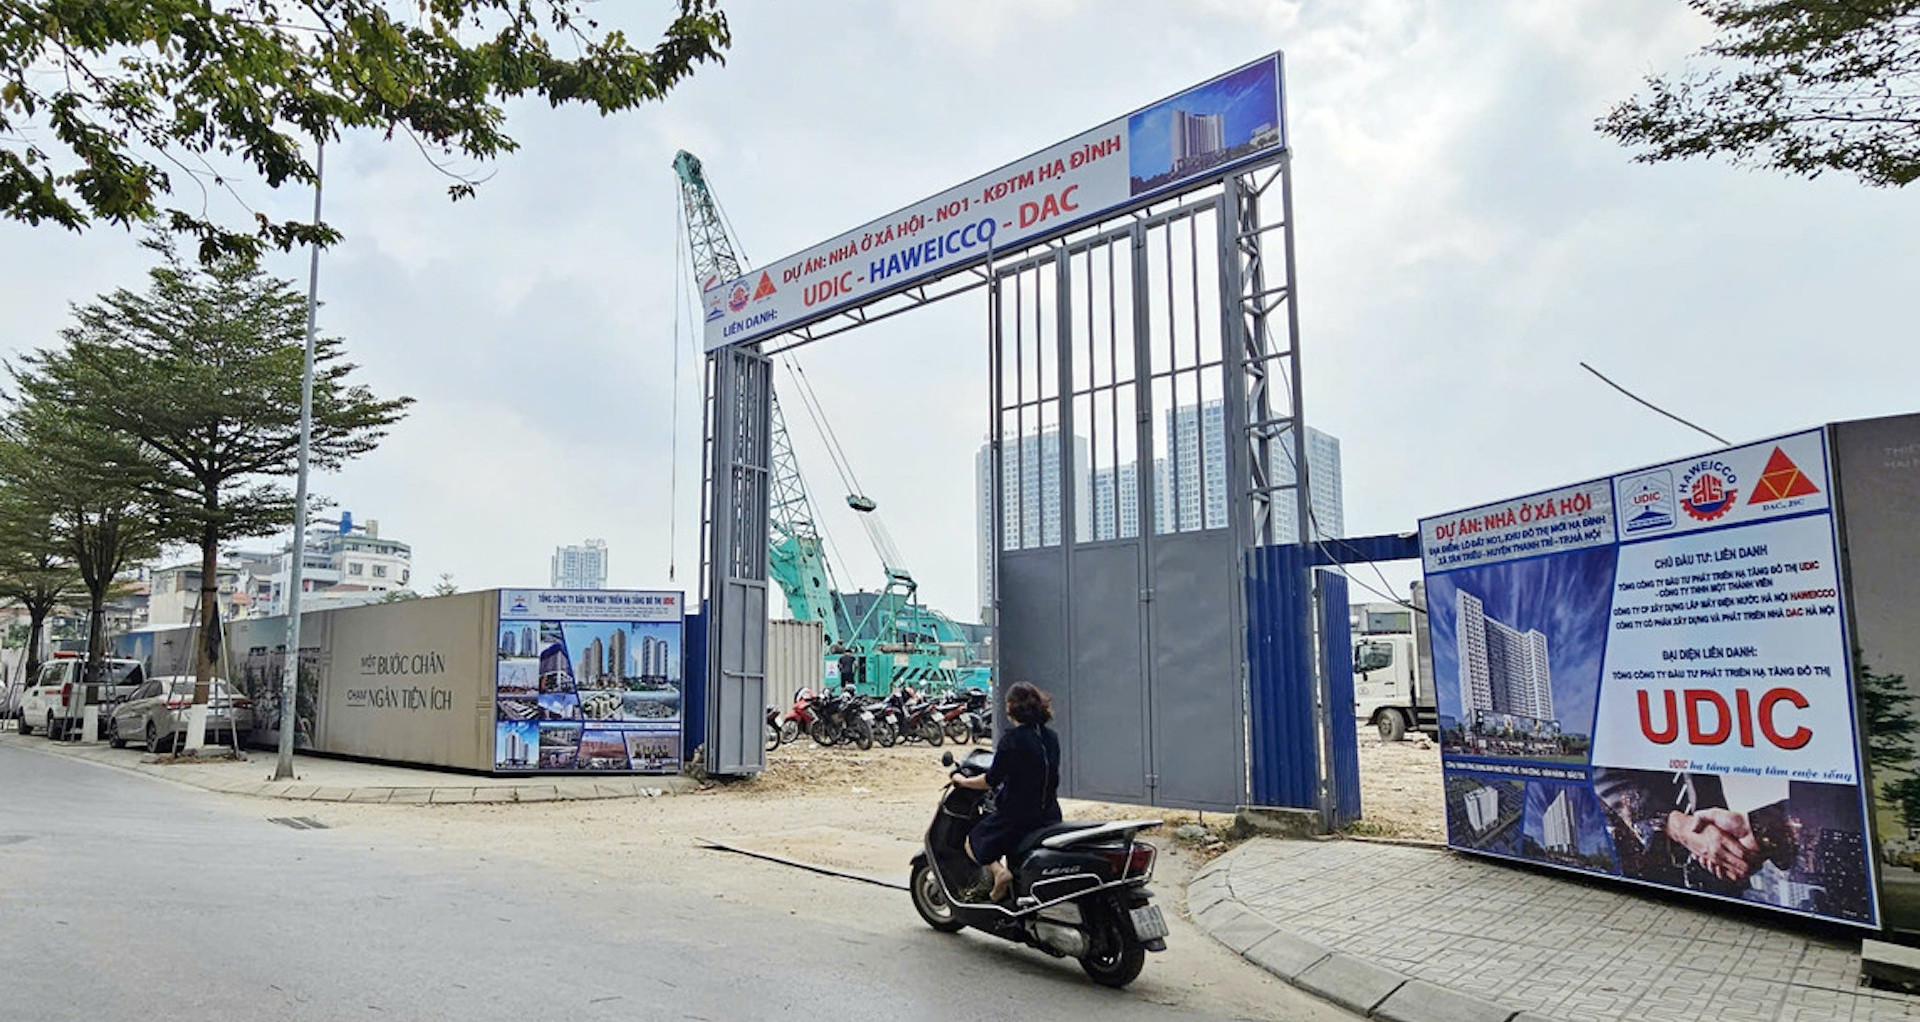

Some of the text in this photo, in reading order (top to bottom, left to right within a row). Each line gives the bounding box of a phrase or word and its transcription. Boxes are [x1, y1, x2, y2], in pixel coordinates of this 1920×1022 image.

[783, 262, 803, 283] DỰ
[804, 255, 826, 275] ÁN:
[829, 240, 858, 265] NHÀ
[861, 233, 872, 252] Ở
[875, 225, 894, 247] XÃ
[898, 215, 924, 237] HỘI
[983, 170, 1034, 204] KĐTM
[1038, 159, 1066, 182] HẠ
[1069, 134, 1120, 170] ĐÌNH
[803, 271, 853, 307] UDIC
[869, 218, 996, 284] HAWEICCO
[1019, 184, 1078, 229] DAC
[746, 309, 778, 330] DANH:
[1679, 460, 1737, 493] HAWEICCO
[1634, 491, 1661, 504] UDIC
[1436, 493, 1592, 541] DỰ ÁN: NHÀ Ở XÃ HỘI
[1715, 547, 1736, 561] LIÊN
[1739, 544, 1768, 558] DANH
[1799, 561, 1819, 571] UDIC
[1790, 588, 1835, 600] HAWEICCO
[1786, 607, 1804, 618] DAC
[1819, 604, 1835, 616] NỘI
[1703, 646, 1724, 658] LIÊN
[1726, 646, 1758, 657] DANH:
[411, 651, 445, 674] CHÂN
[1797, 664, 1811, 676] ĐÔ
[1813, 666, 1831, 677] THỊ
[402, 686, 427, 712] TIỆN
[431, 686, 452, 710] ÍCH
[1637, 687, 1813, 750] UDIC
[1669, 759, 1688, 769] UDIC
